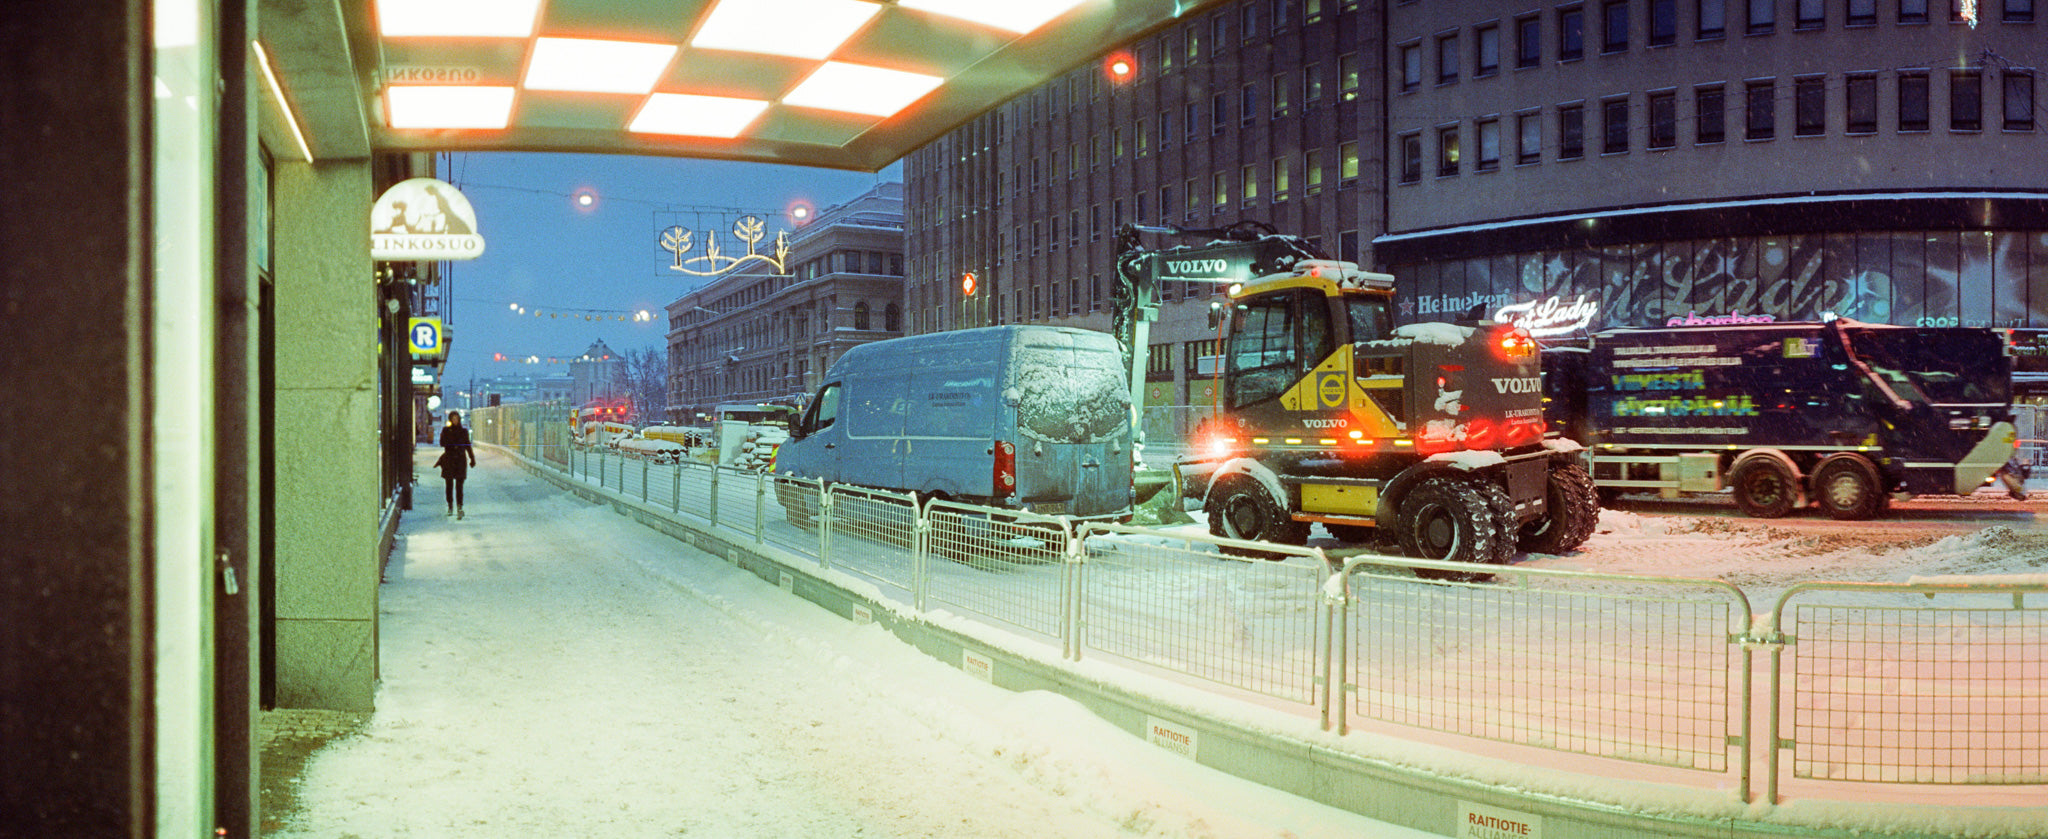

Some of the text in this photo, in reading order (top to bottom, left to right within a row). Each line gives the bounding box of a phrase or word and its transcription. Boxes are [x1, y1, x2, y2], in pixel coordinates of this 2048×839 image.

[1166, 259, 1227, 274] VOLVO
[1418, 291, 1506, 314] Heineken
[1533, 294, 1598, 333] Lady
[416, 325, 434, 346] R
[1302, 418, 1347, 429] VOLVO
[1469, 812, 1532, 835] RAITIOTIE-
